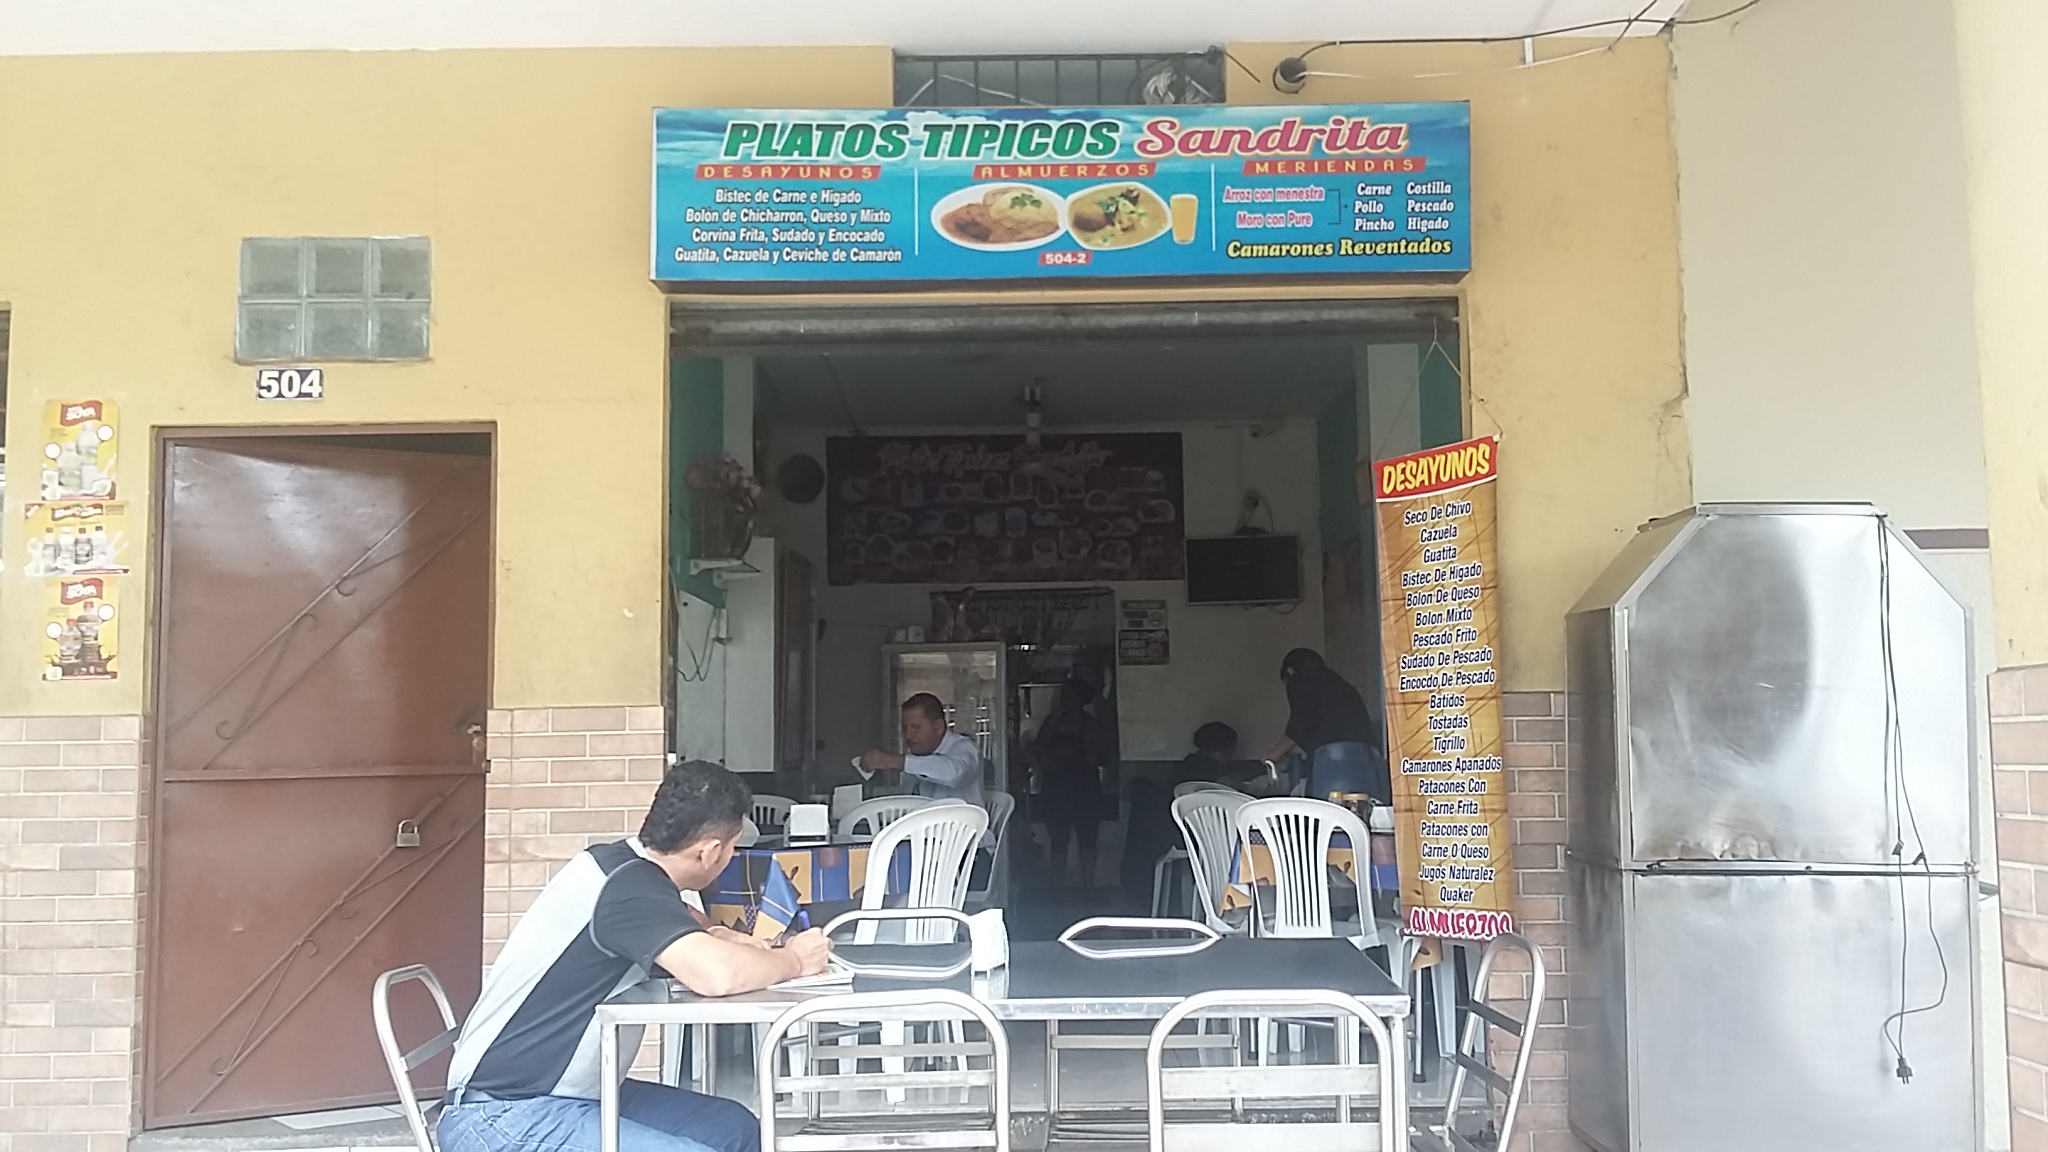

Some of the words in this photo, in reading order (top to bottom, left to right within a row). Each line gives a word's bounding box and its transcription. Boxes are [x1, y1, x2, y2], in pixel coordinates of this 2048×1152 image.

[721, 122, 909, 159] PLATOS
[920, 120, 1119, 158] TIPICOS
[1136, 116, 1409, 158] Sandrita
[704, 166, 873, 179] DESAYUNOS
[981, 164, 1149, 179] ALMUERZOS
[1255, 159, 1415, 174] MERIENDAS
[1224, 186, 1251, 202] Arroz
[1254, 188, 1273, 202] con
[1276, 185, 1325, 201] menestra
[1357, 182, 1392, 196] Carne
[1406, 181, 1451, 195] Costilla
[715, 188, 751, 203] Bistec
[755, 189, 769, 203] de
[773, 188, 807, 203] Carne
[810, 191, 818, 203] e
[821, 189, 862, 207] Higado
[1354, 200, 1384, 213] Pollo
[1407, 199, 1454, 213] Pescado
[722, 208, 737, 222] de
[811, 208, 847, 223] Queso
[850, 212, 857, 226] y
[860, 209, 891, 223] Mixto
[1236, 211, 1263, 228] Moro
[1265, 213, 1285, 227] con
[1287, 210, 1313, 227] Pure
[1354, 217, 1395, 231] Pincho
[1407, 216, 1449, 233] Higado
[692, 227, 736, 242] Corvina
[739, 228, 768, 244] Frita,
[772, 227, 815, 242] Sudado
[818, 231, 826, 246] y
[828, 228, 885, 242] Encocado
[675, 246, 719, 264] Guatita,
[723, 247, 769, 262] Cazuela
[772, 250, 780, 265] y
[783, 247, 829, 262] Ceviche
[832, 248, 847, 262] de
[1227, 240, 1334, 258] Camarones
[1339, 237, 1452, 256] Reventados
[1045, 252, 1087, 264] 504-2
[259, 368, 322, 398] 504
[1382, 443, 1490, 496] DESAYUNOS
[1404, 510, 1428, 525] Seco
[1430, 506, 1442, 521] De
[1445, 501, 1471, 518] Chivo
[1420, 524, 1457, 543] Cazuela
[1423, 546, 1457, 563] Guatita
[1402, 571, 1431, 587] Bistec
[1434, 568, 1447, 583] De
[1449, 562, 1482, 582] Higado
[1406, 592, 1433, 607] Bolon
[1436, 589, 1449, 603] De
[1451, 586, 1480, 602] Queso
[1415, 611, 1443, 626] Bolon
[1446, 607, 1472, 623] Mixto
[1413, 630, 1453, 647] Pescado
[1455, 628, 1477, 643] Frito
[1401, 653, 1435, 670] Sudado
[1438, 652, 1450, 666] De
[1453, 647, 1492, 664] Pescado
[1441, 672, 1453, 687] De
[1455, 669, 1495, 685] Pescado
[1430, 693, 1465, 709] Batidos
[1428, 714, 1468, 730] Tostadas
[1433, 736, 1465, 754] Tigrillo
[1402, 759, 1452, 774] Camarones
[1455, 756, 1502, 774] Apanados
[1419, 779, 1466, 793] Patacones
[1468, 778, 1486, 793] Con
[1427, 800, 1454, 815] Carne
[1457, 799, 1479, 815] Frita
[1420, 821, 1468, 837] Patacones
[1471, 824, 1488, 836] con
[1422, 842, 1449, 858] Carne
[1451, 843, 1458, 858] O
[1460, 843, 1489, 859] Queso
[1419, 864, 1446, 882] Jugos
[1448, 865, 1494, 881] Naturalez
[1440, 886, 1474, 902] Quaker
